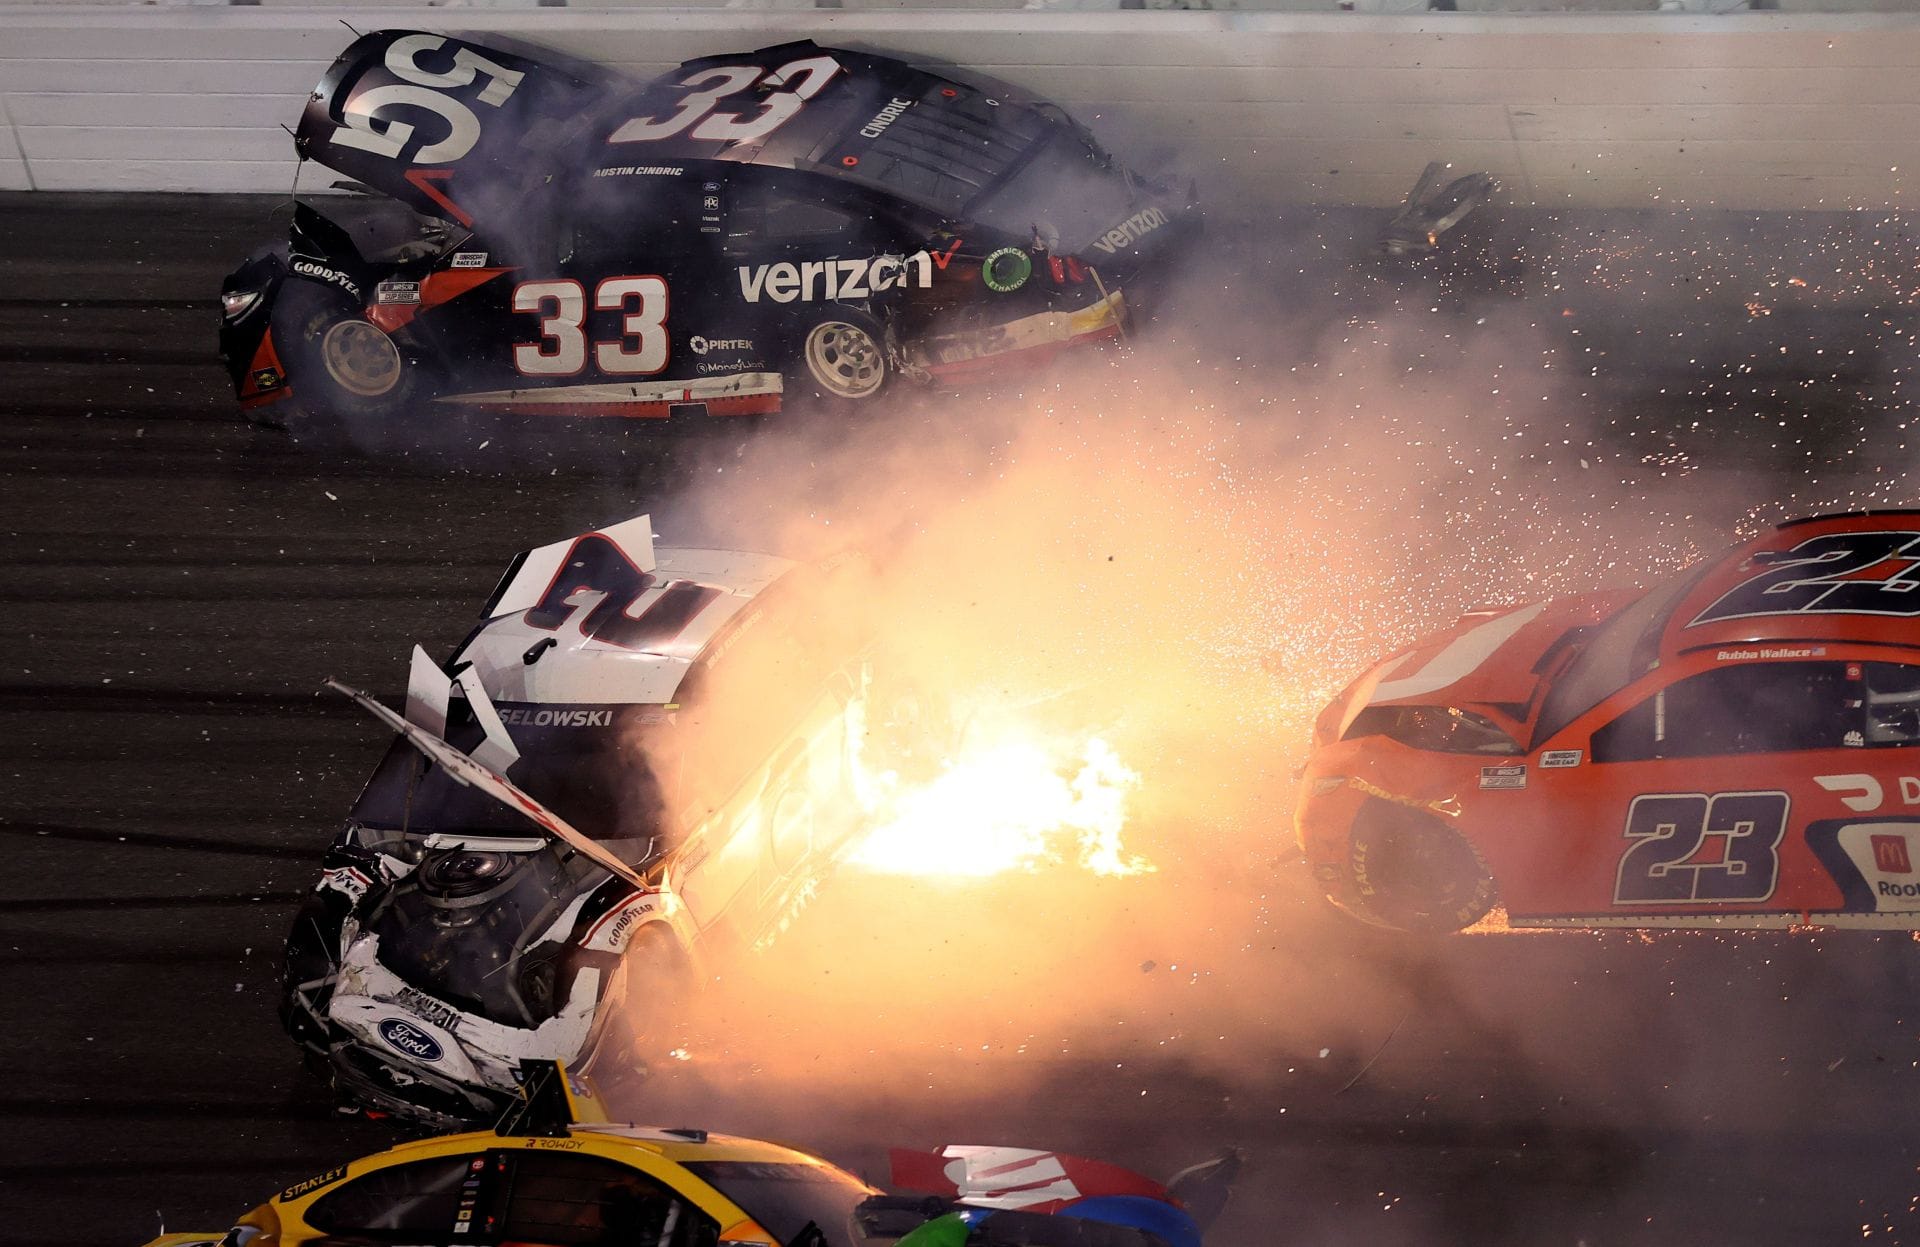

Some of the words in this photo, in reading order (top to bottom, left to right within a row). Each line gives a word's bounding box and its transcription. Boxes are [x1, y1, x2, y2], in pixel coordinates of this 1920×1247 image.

[606, 55, 843, 145] 33
[860, 97, 912, 138] CINDRIC
[593, 167, 635, 177] AUSTIN
[635, 166, 684, 176] CINDRIC
[1092, 207, 1169, 253] verizon
[987, 247, 1028, 264] AMERICAN
[738, 249, 932, 303] verizon
[988, 276, 1028, 292] ETHANOL
[511, 274, 670, 377] 33
[709, 339, 753, 350] PIRTEK
[708, 360, 765, 372] MoneyLion
[1717, 651, 1759, 660] Bubba
[1760, 649, 1811, 658] Wallace
[466, 709, 613, 727] SELOWSKI
[1614, 791, 1791, 905] 23
[1353, 840, 1375, 896] EAGLE
[608, 903, 655, 947] GOODYEAR
[388, 1024, 431, 1055] Ford
[540, 1139, 585, 1150] ROWDY
[284, 1165, 344, 1198] STANLEY
